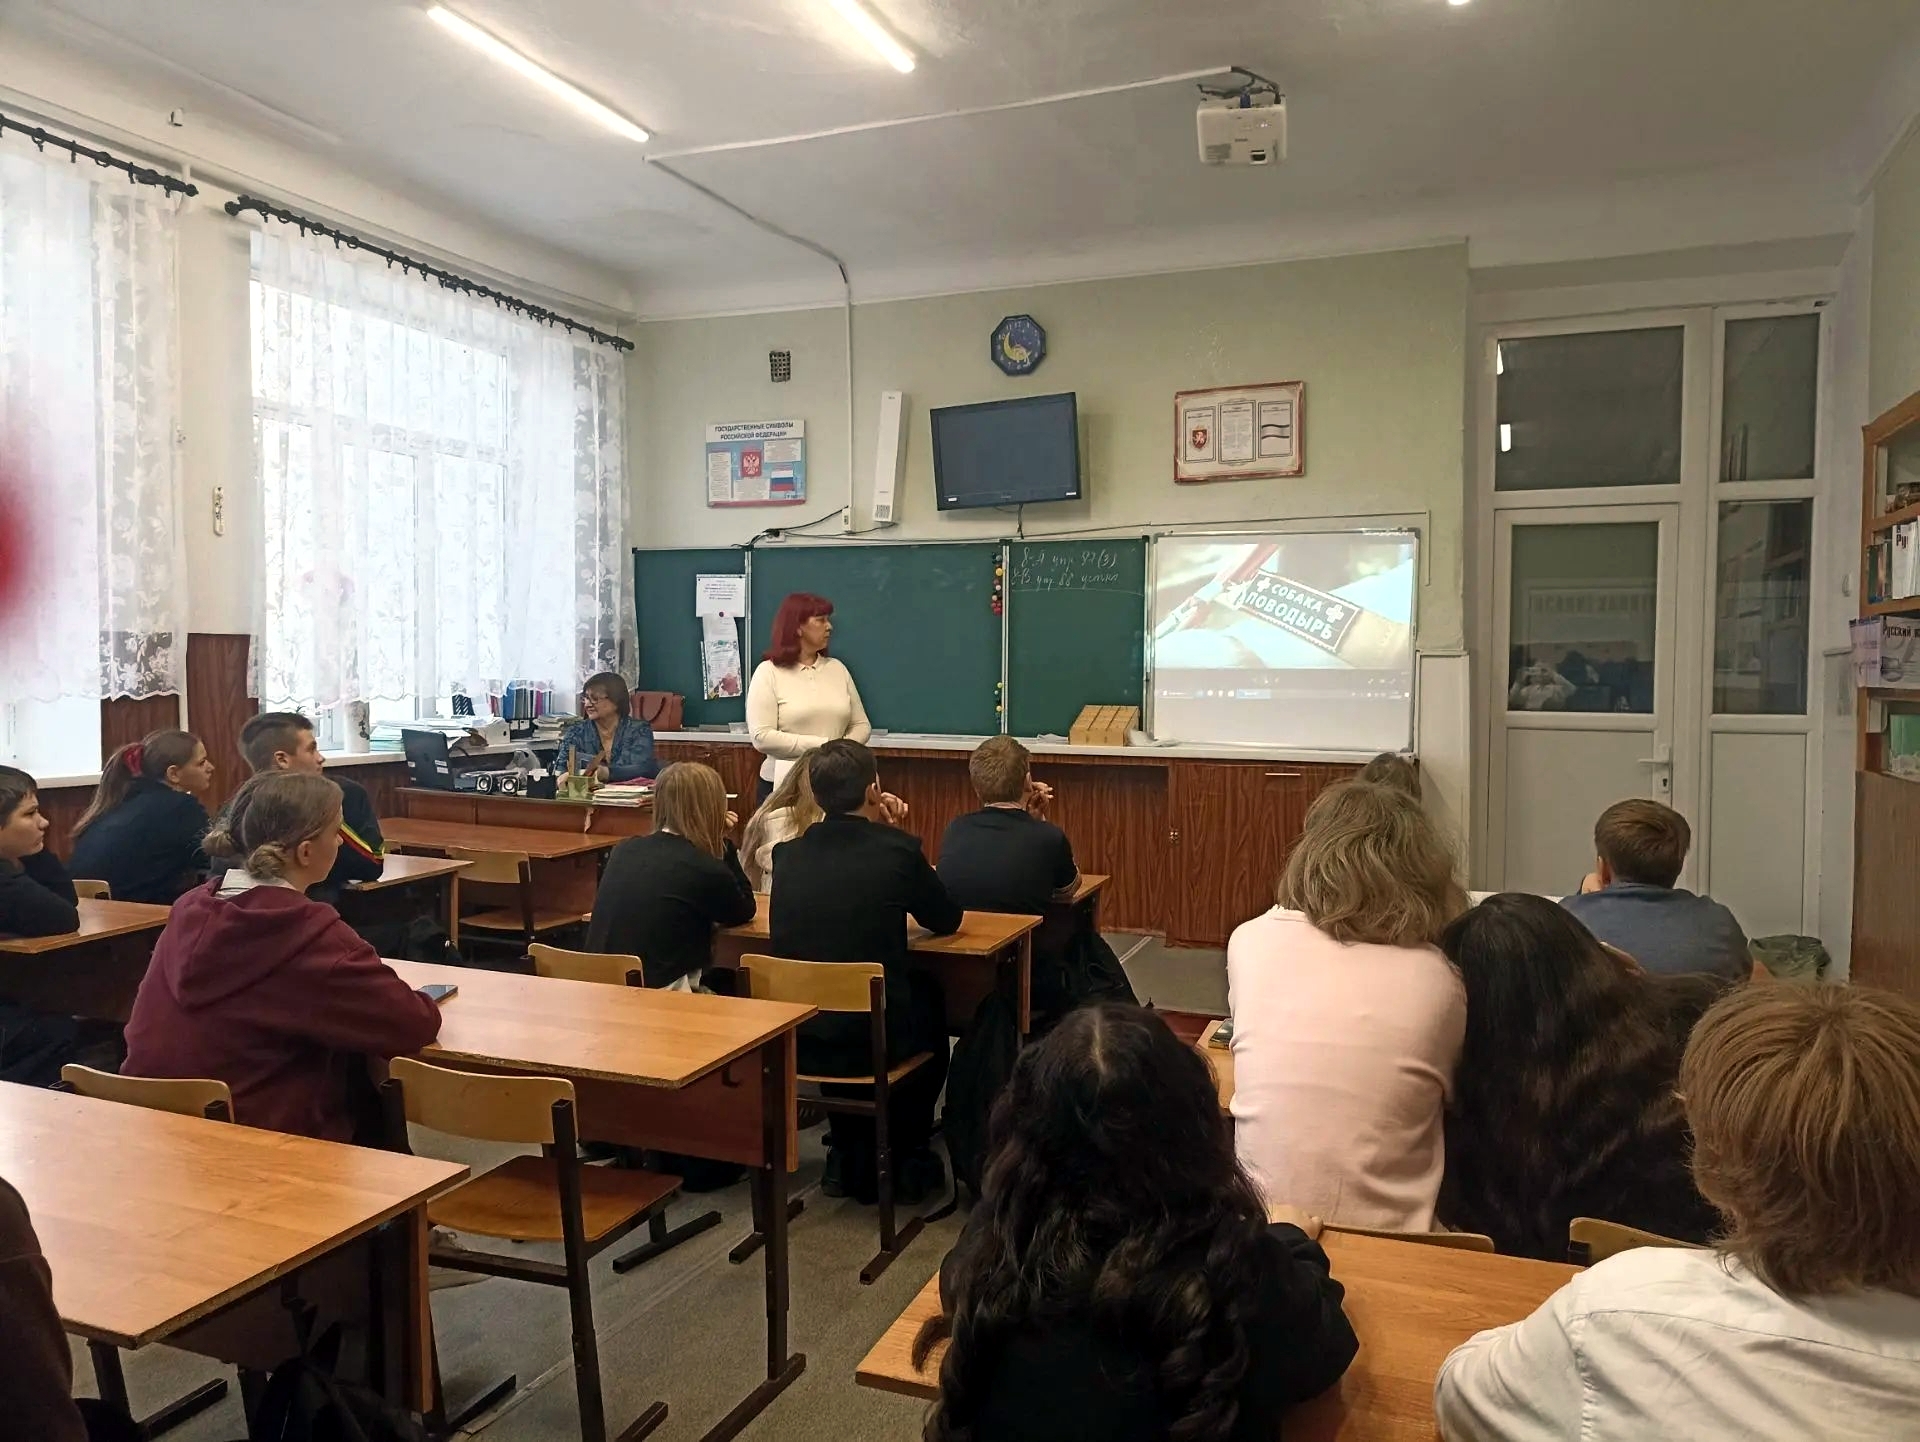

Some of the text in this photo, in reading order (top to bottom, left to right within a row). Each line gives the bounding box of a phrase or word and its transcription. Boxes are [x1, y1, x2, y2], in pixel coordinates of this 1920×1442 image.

[715, 421, 794, 432] ГОСУДАРСТВЕННЫЕ СИМВОЛЫ
[720, 431, 755, 440] РОССИЙСКОЙ
[1896, 533, 1909, 548] Ру
[1271, 583, 1323, 613] СОБАКА
[1246, 592, 1333, 640] ПОВОДЫРЬ
[1882, 623, 1912, 639] Русский
